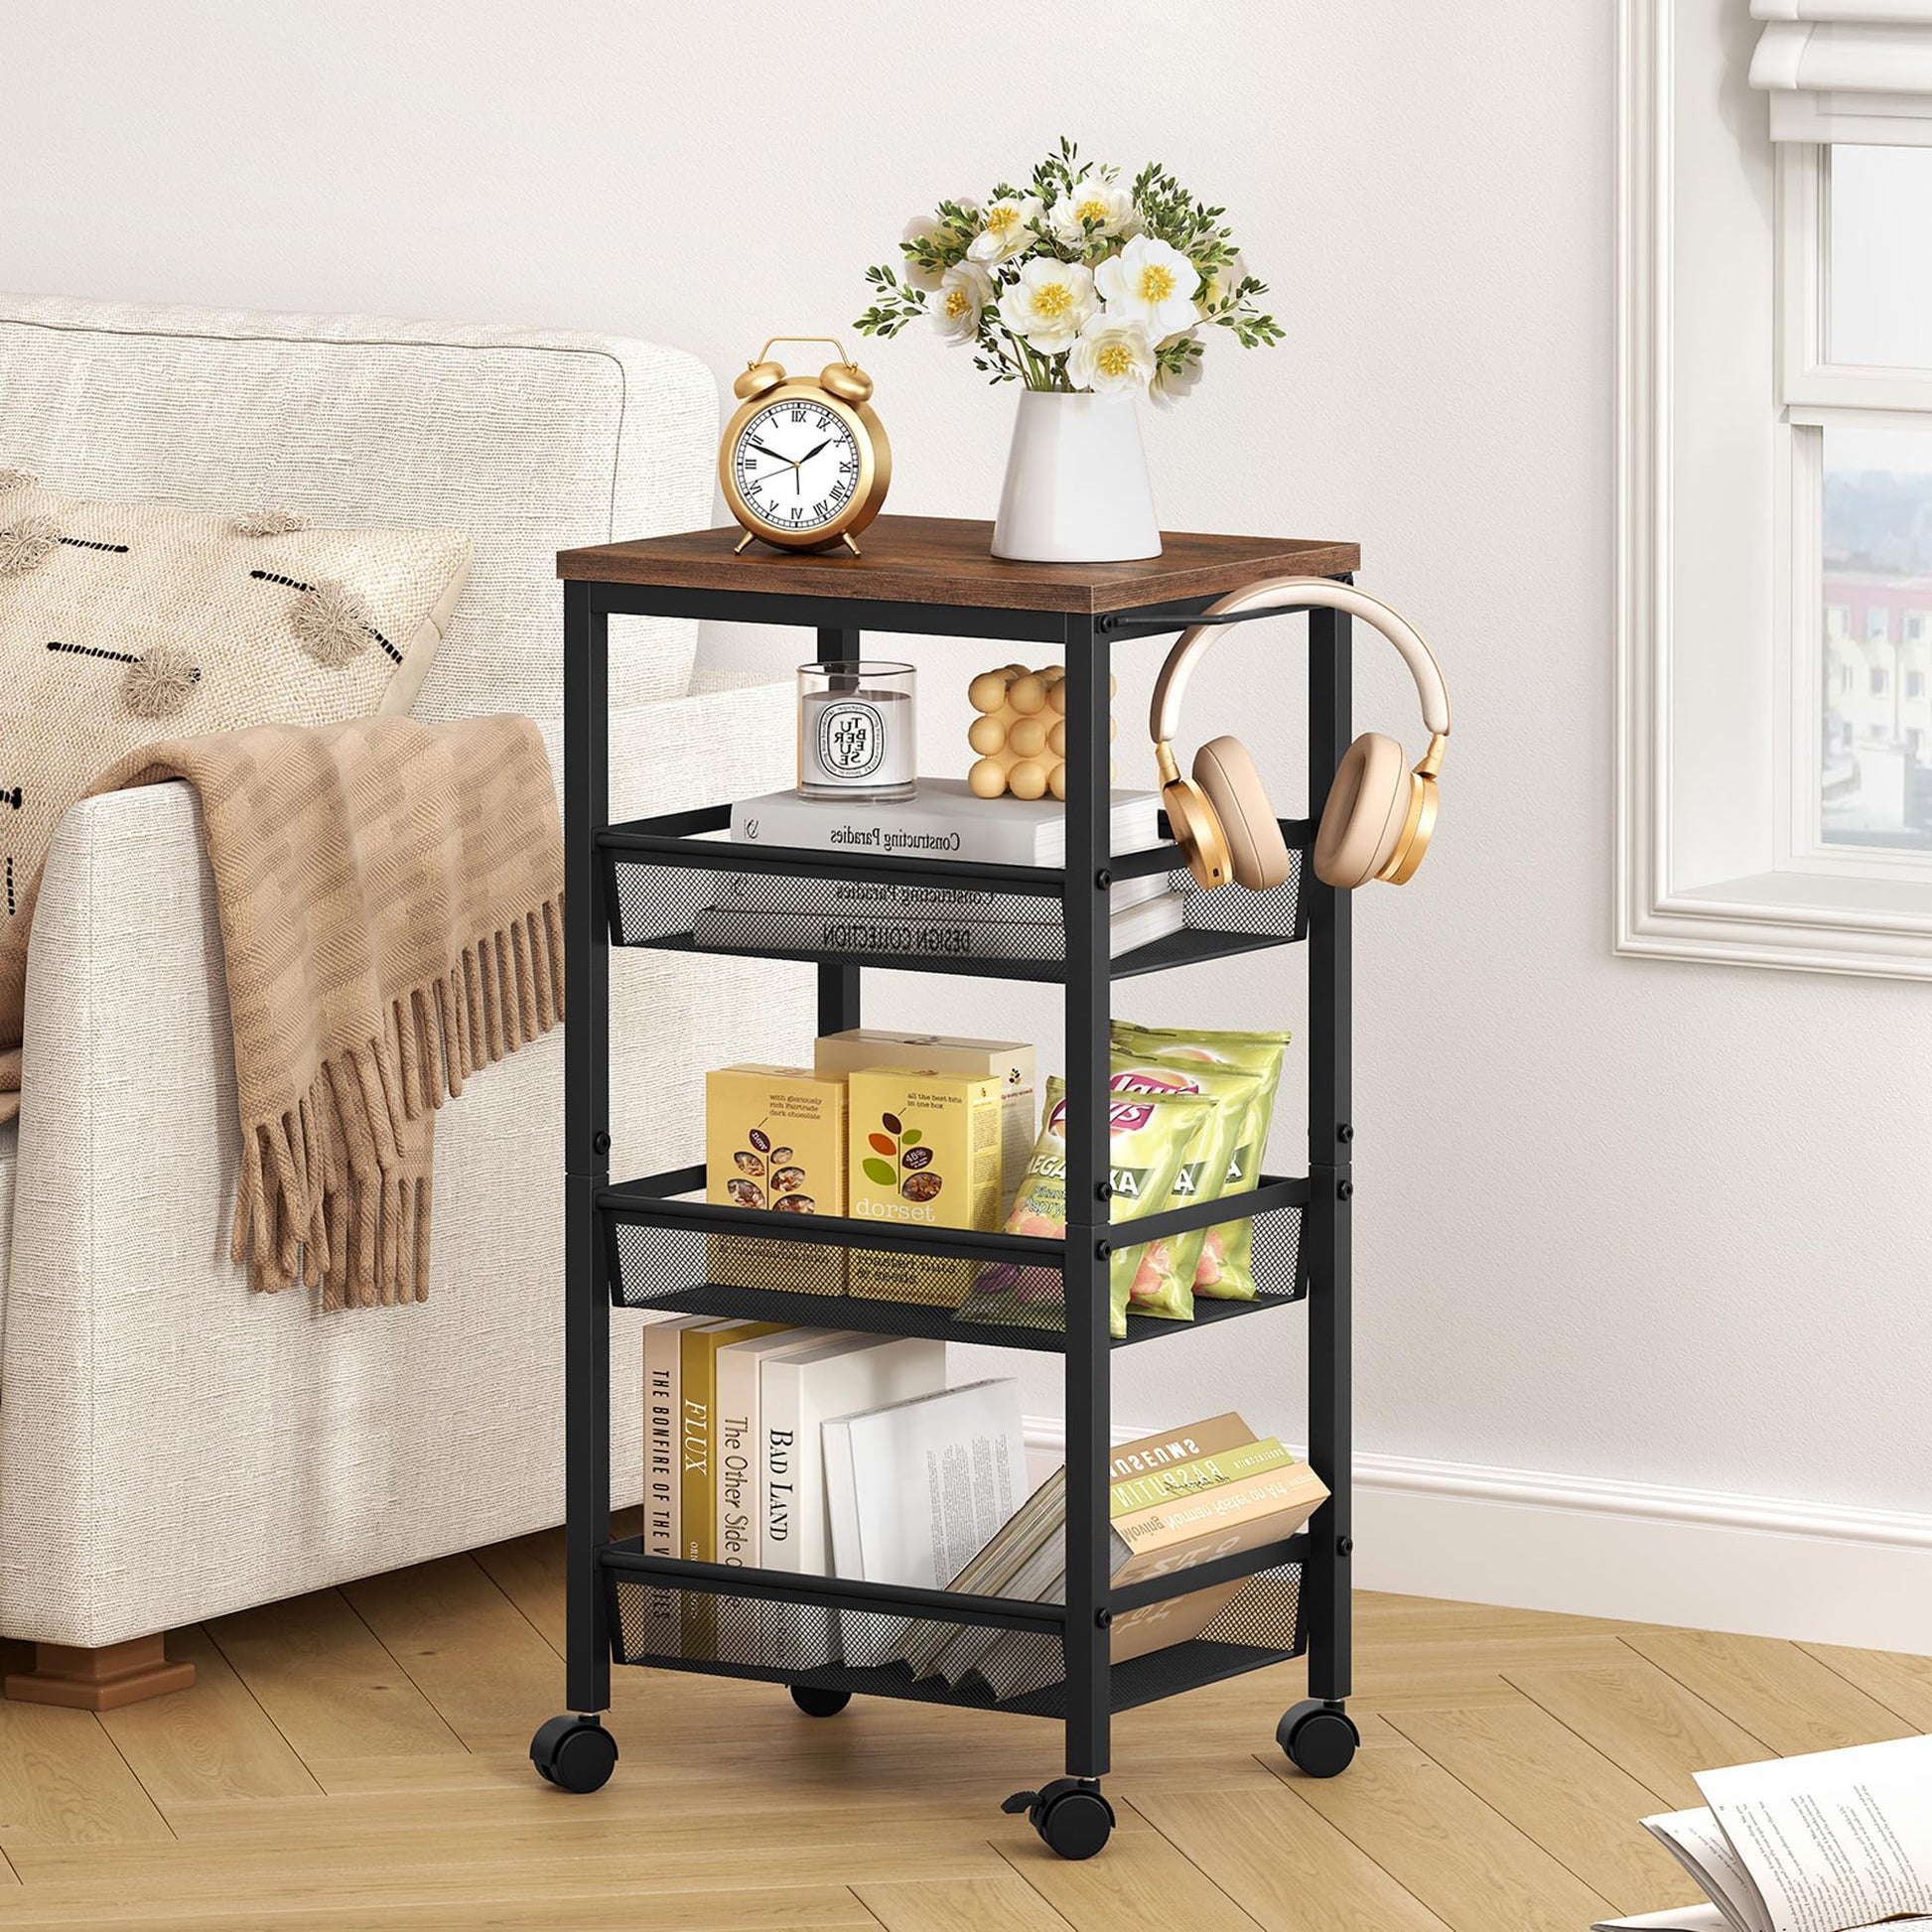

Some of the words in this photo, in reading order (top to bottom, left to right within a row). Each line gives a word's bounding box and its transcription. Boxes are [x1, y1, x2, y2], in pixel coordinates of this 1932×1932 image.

[855, 1197, 936, 1222] dorset
[652, 1370, 669, 1398] THE
[652, 1406, 669, 1474] BONFIRE
[684, 1398, 707, 1477] FLUX
[724, 1417, 749, 1450] The
[652, 1482, 670, 1502] OF
[724, 1455, 749, 1508] Other
[652, 1511, 670, 1539] THE
[724, 1513, 750, 1553] Side
